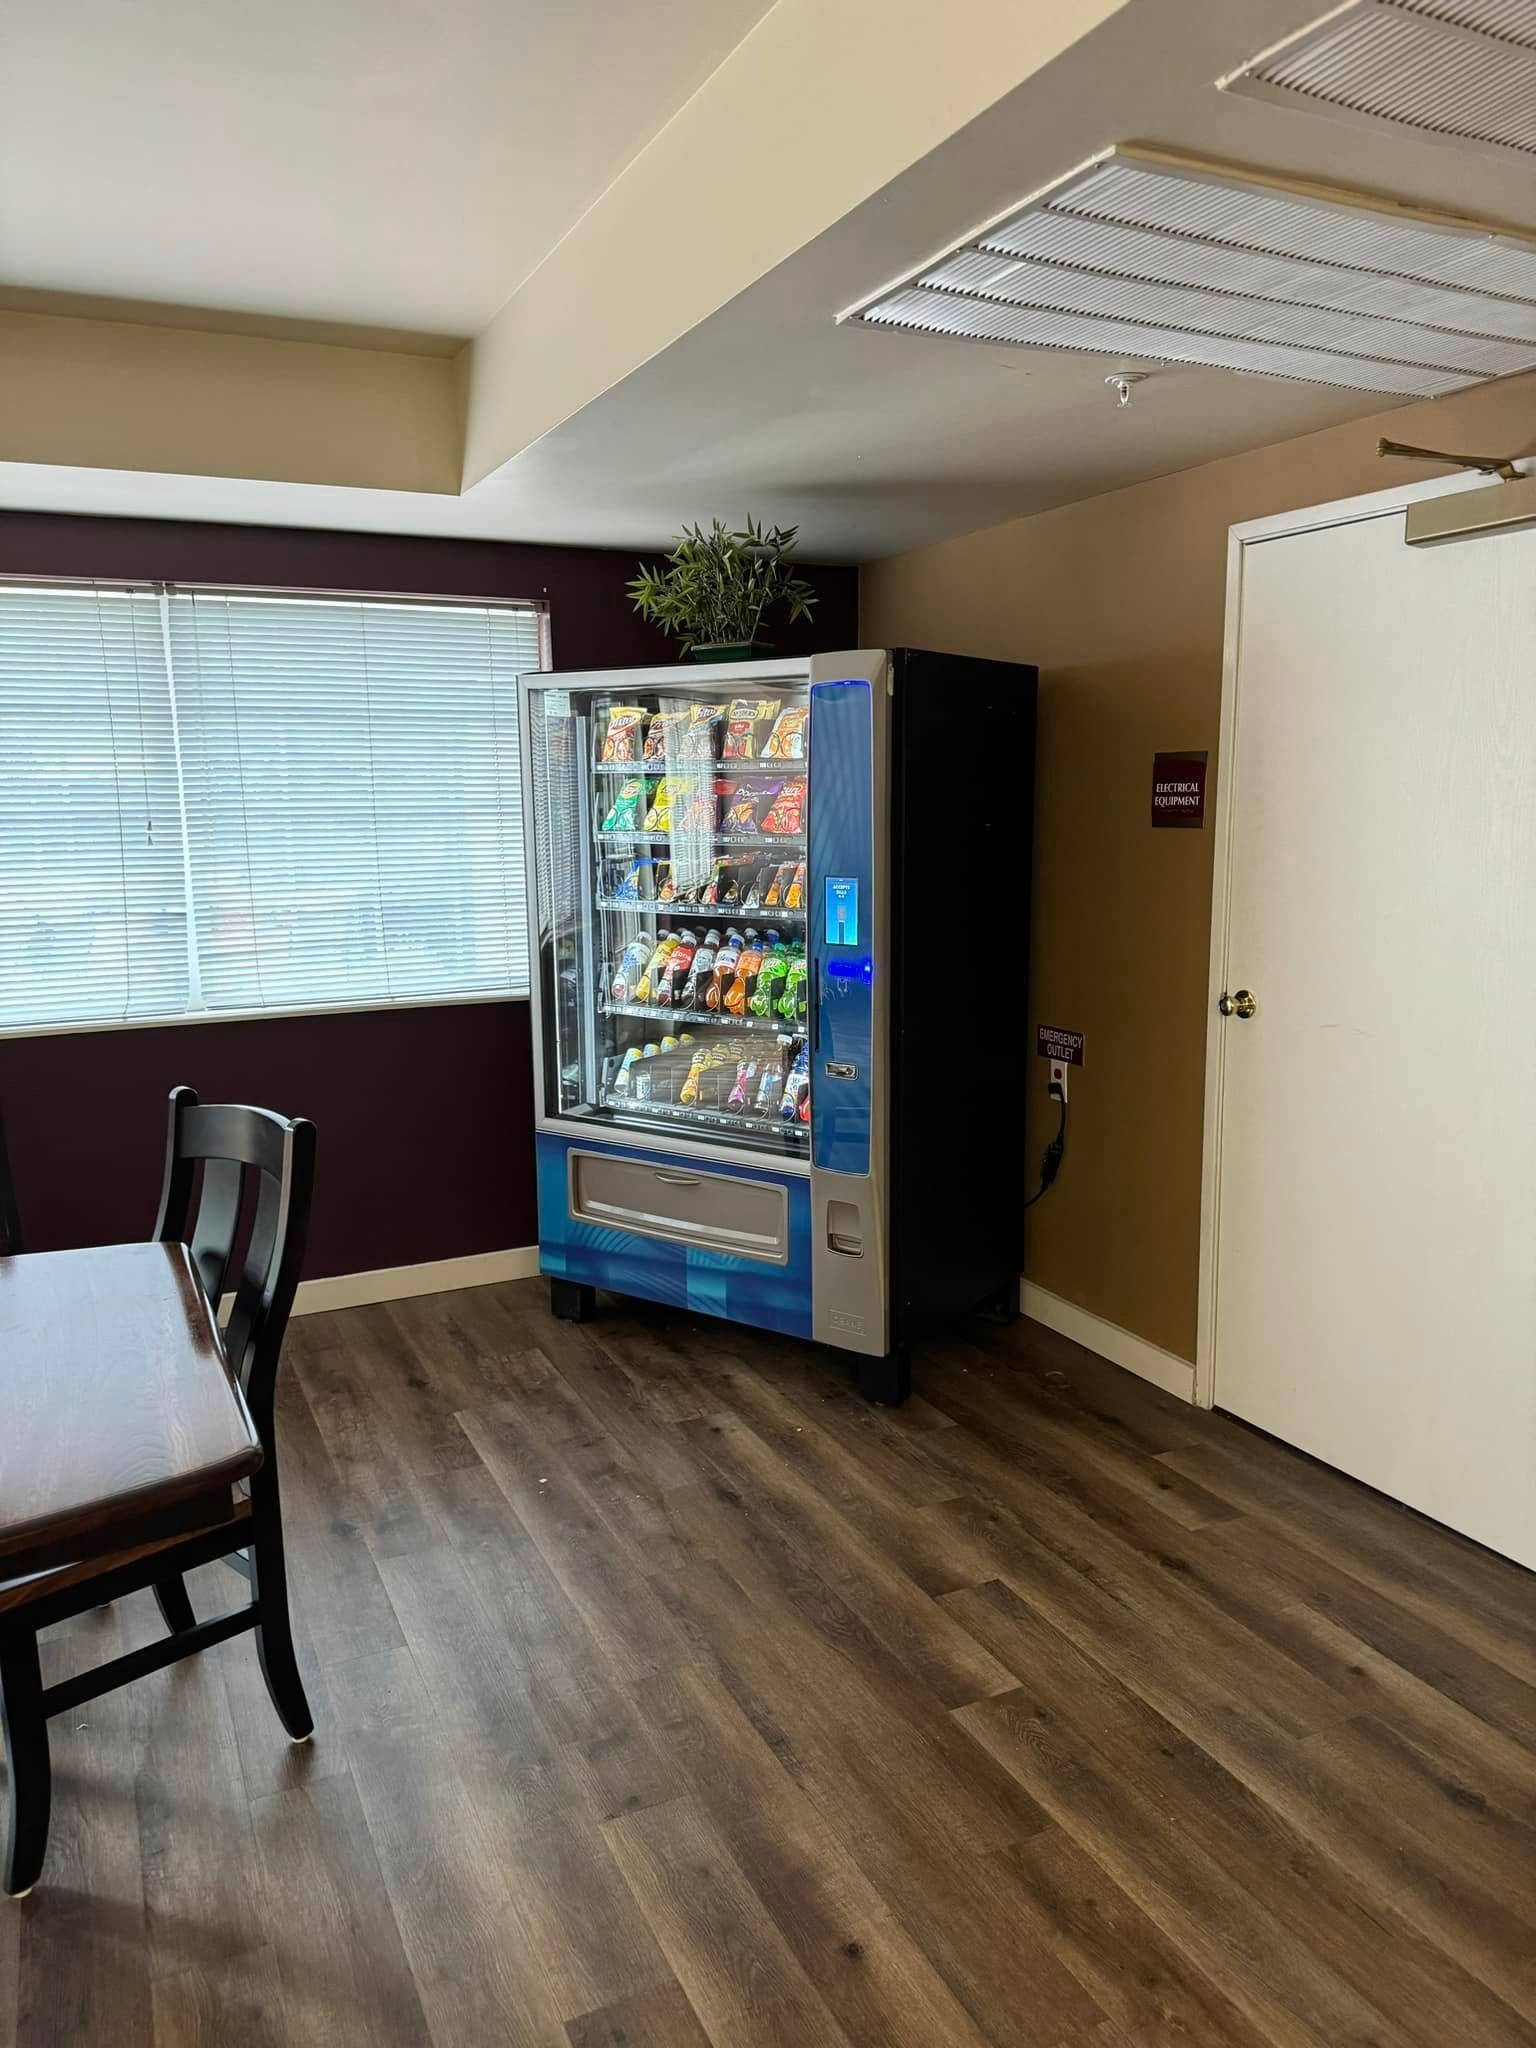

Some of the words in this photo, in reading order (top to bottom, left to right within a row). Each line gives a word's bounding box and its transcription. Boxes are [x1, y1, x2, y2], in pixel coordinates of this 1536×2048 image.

[1156, 783, 1200, 793] ELECTRICAL
[1154, 795, 1201, 808] EQUIPMENT
[1039, 1028, 1083, 1049] EMERGENCY
[1046, 1043, 1075, 1060] OUTLET
